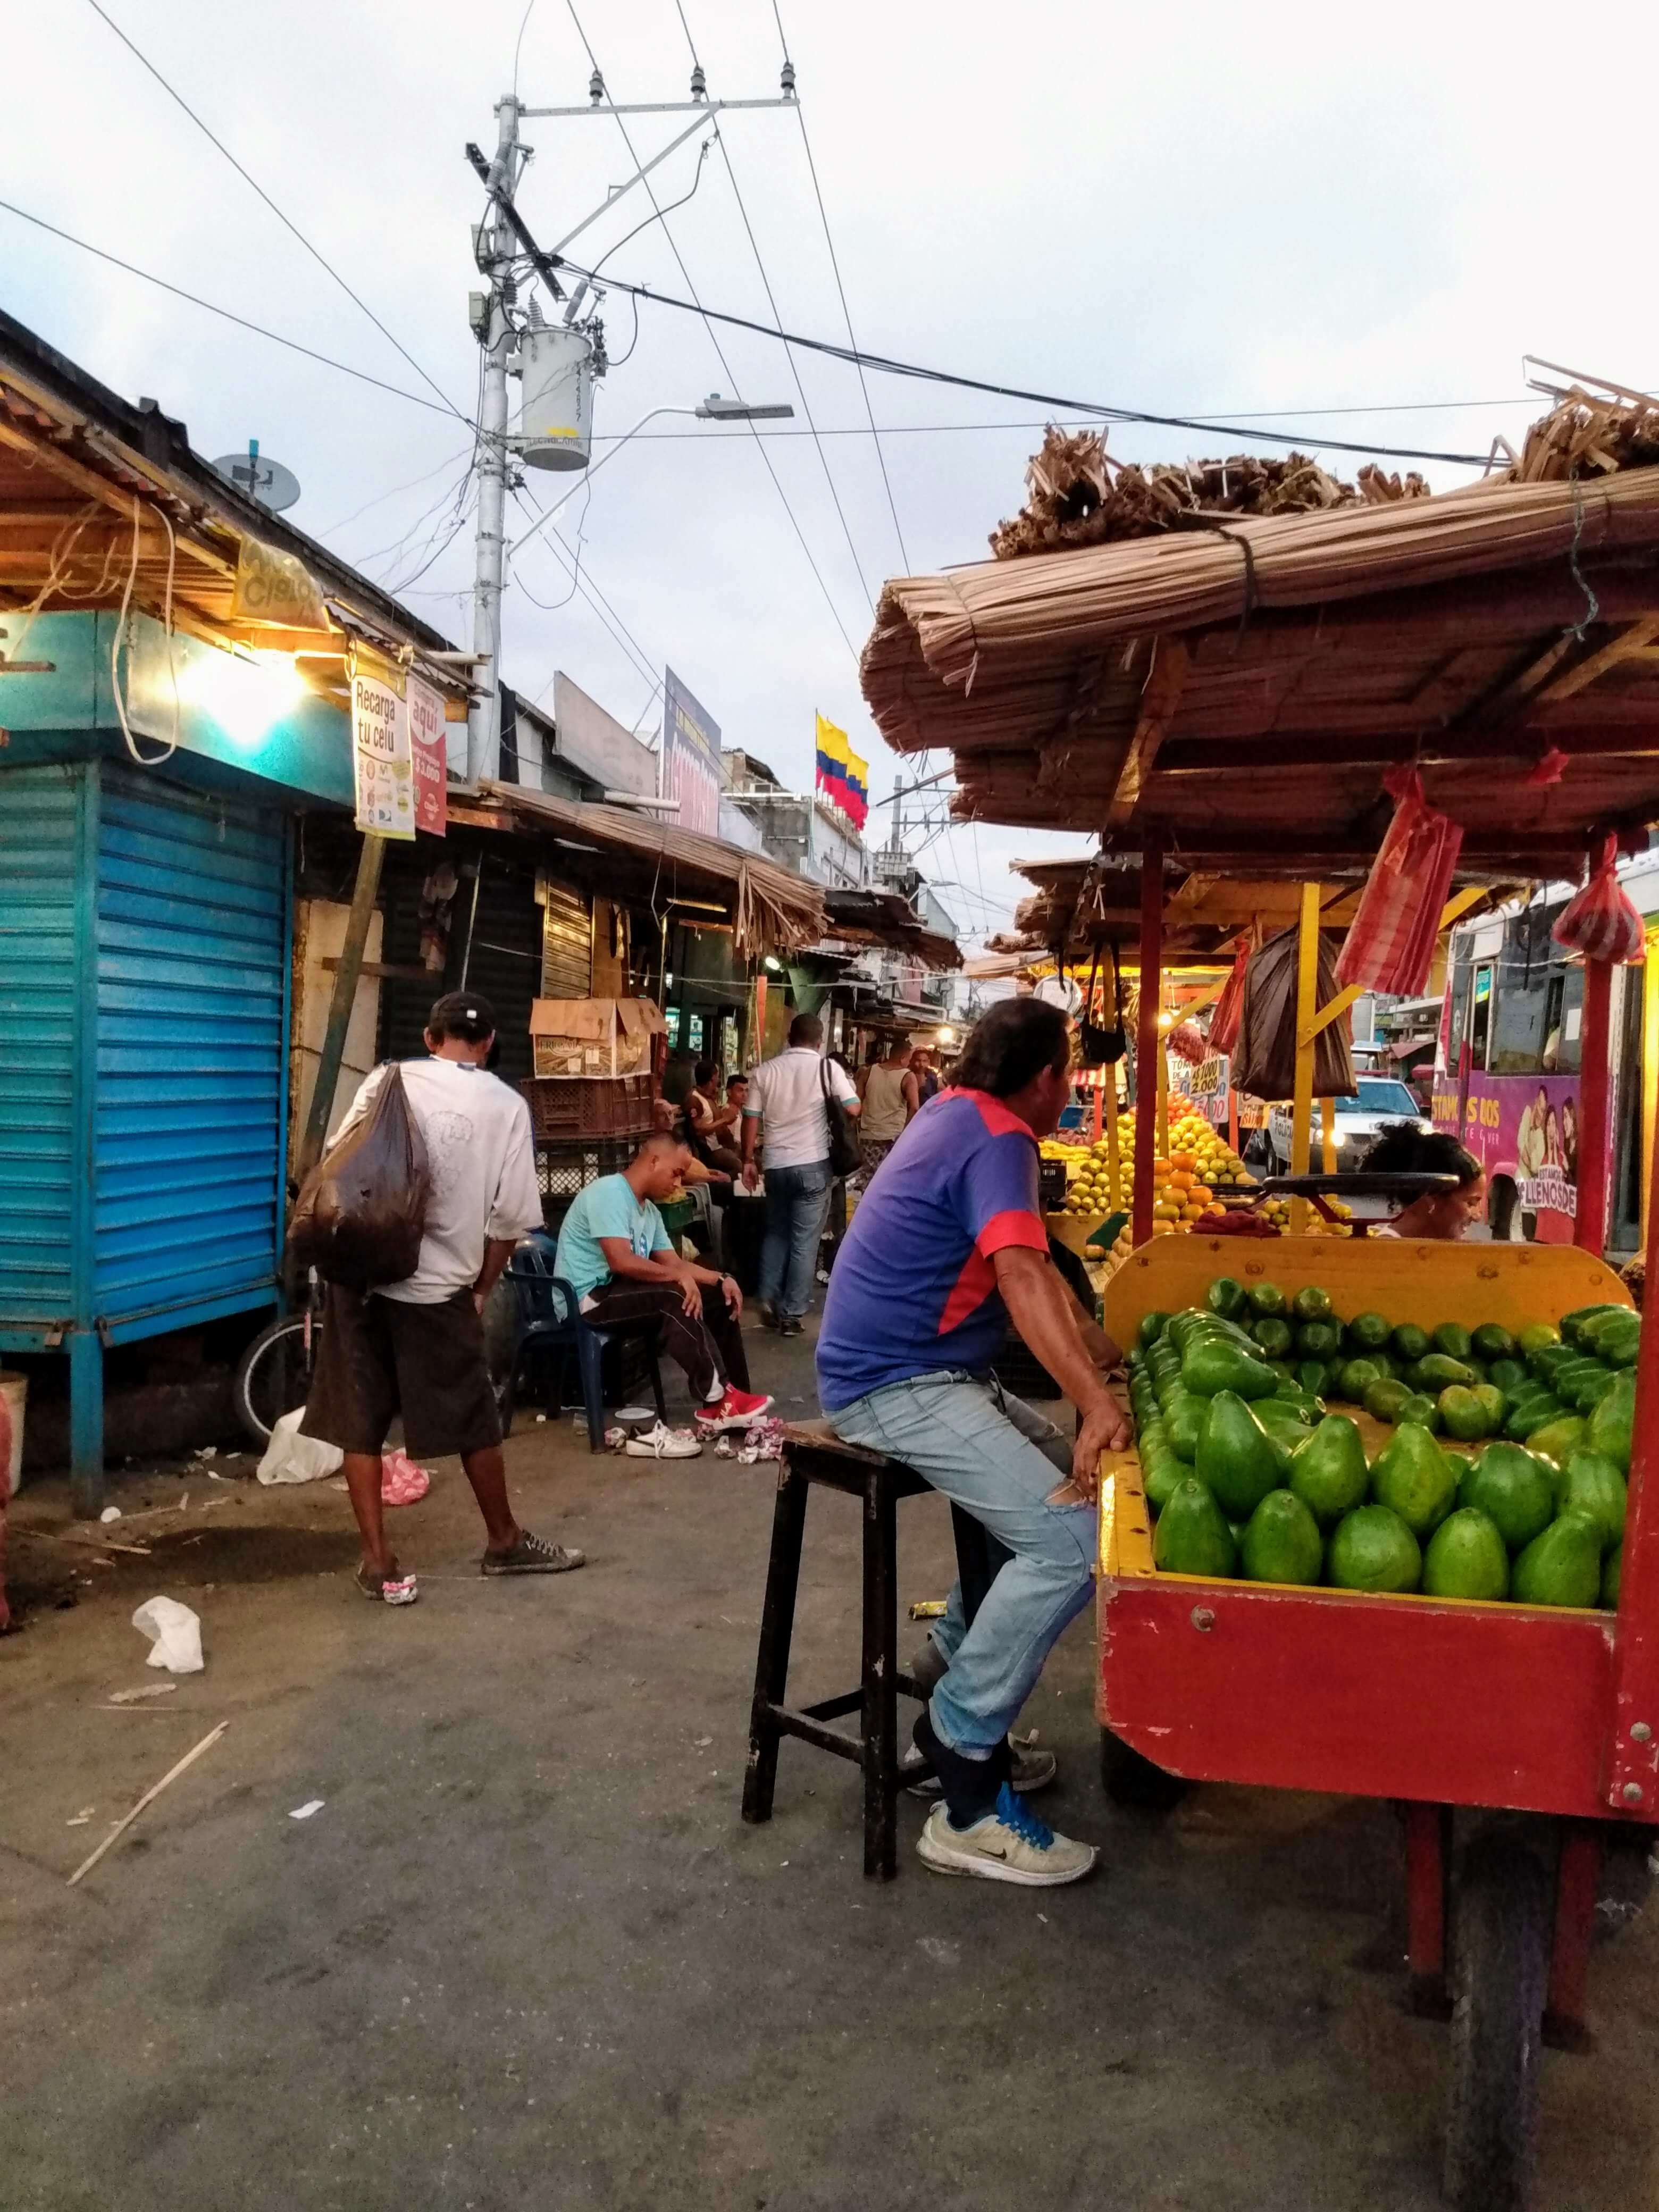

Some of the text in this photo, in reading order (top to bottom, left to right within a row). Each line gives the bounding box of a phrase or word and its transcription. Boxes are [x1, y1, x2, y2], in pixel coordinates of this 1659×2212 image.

[357, 680, 395, 725] Recarga
[413, 700, 438, 739] aquí
[358, 717, 395, 752] tu celu
[1191, 1076, 1218, 1094] 2.000
[1275, 1121, 1294, 1140] POLICI
[1539, 1168, 1562, 1181] ESTAMOS
